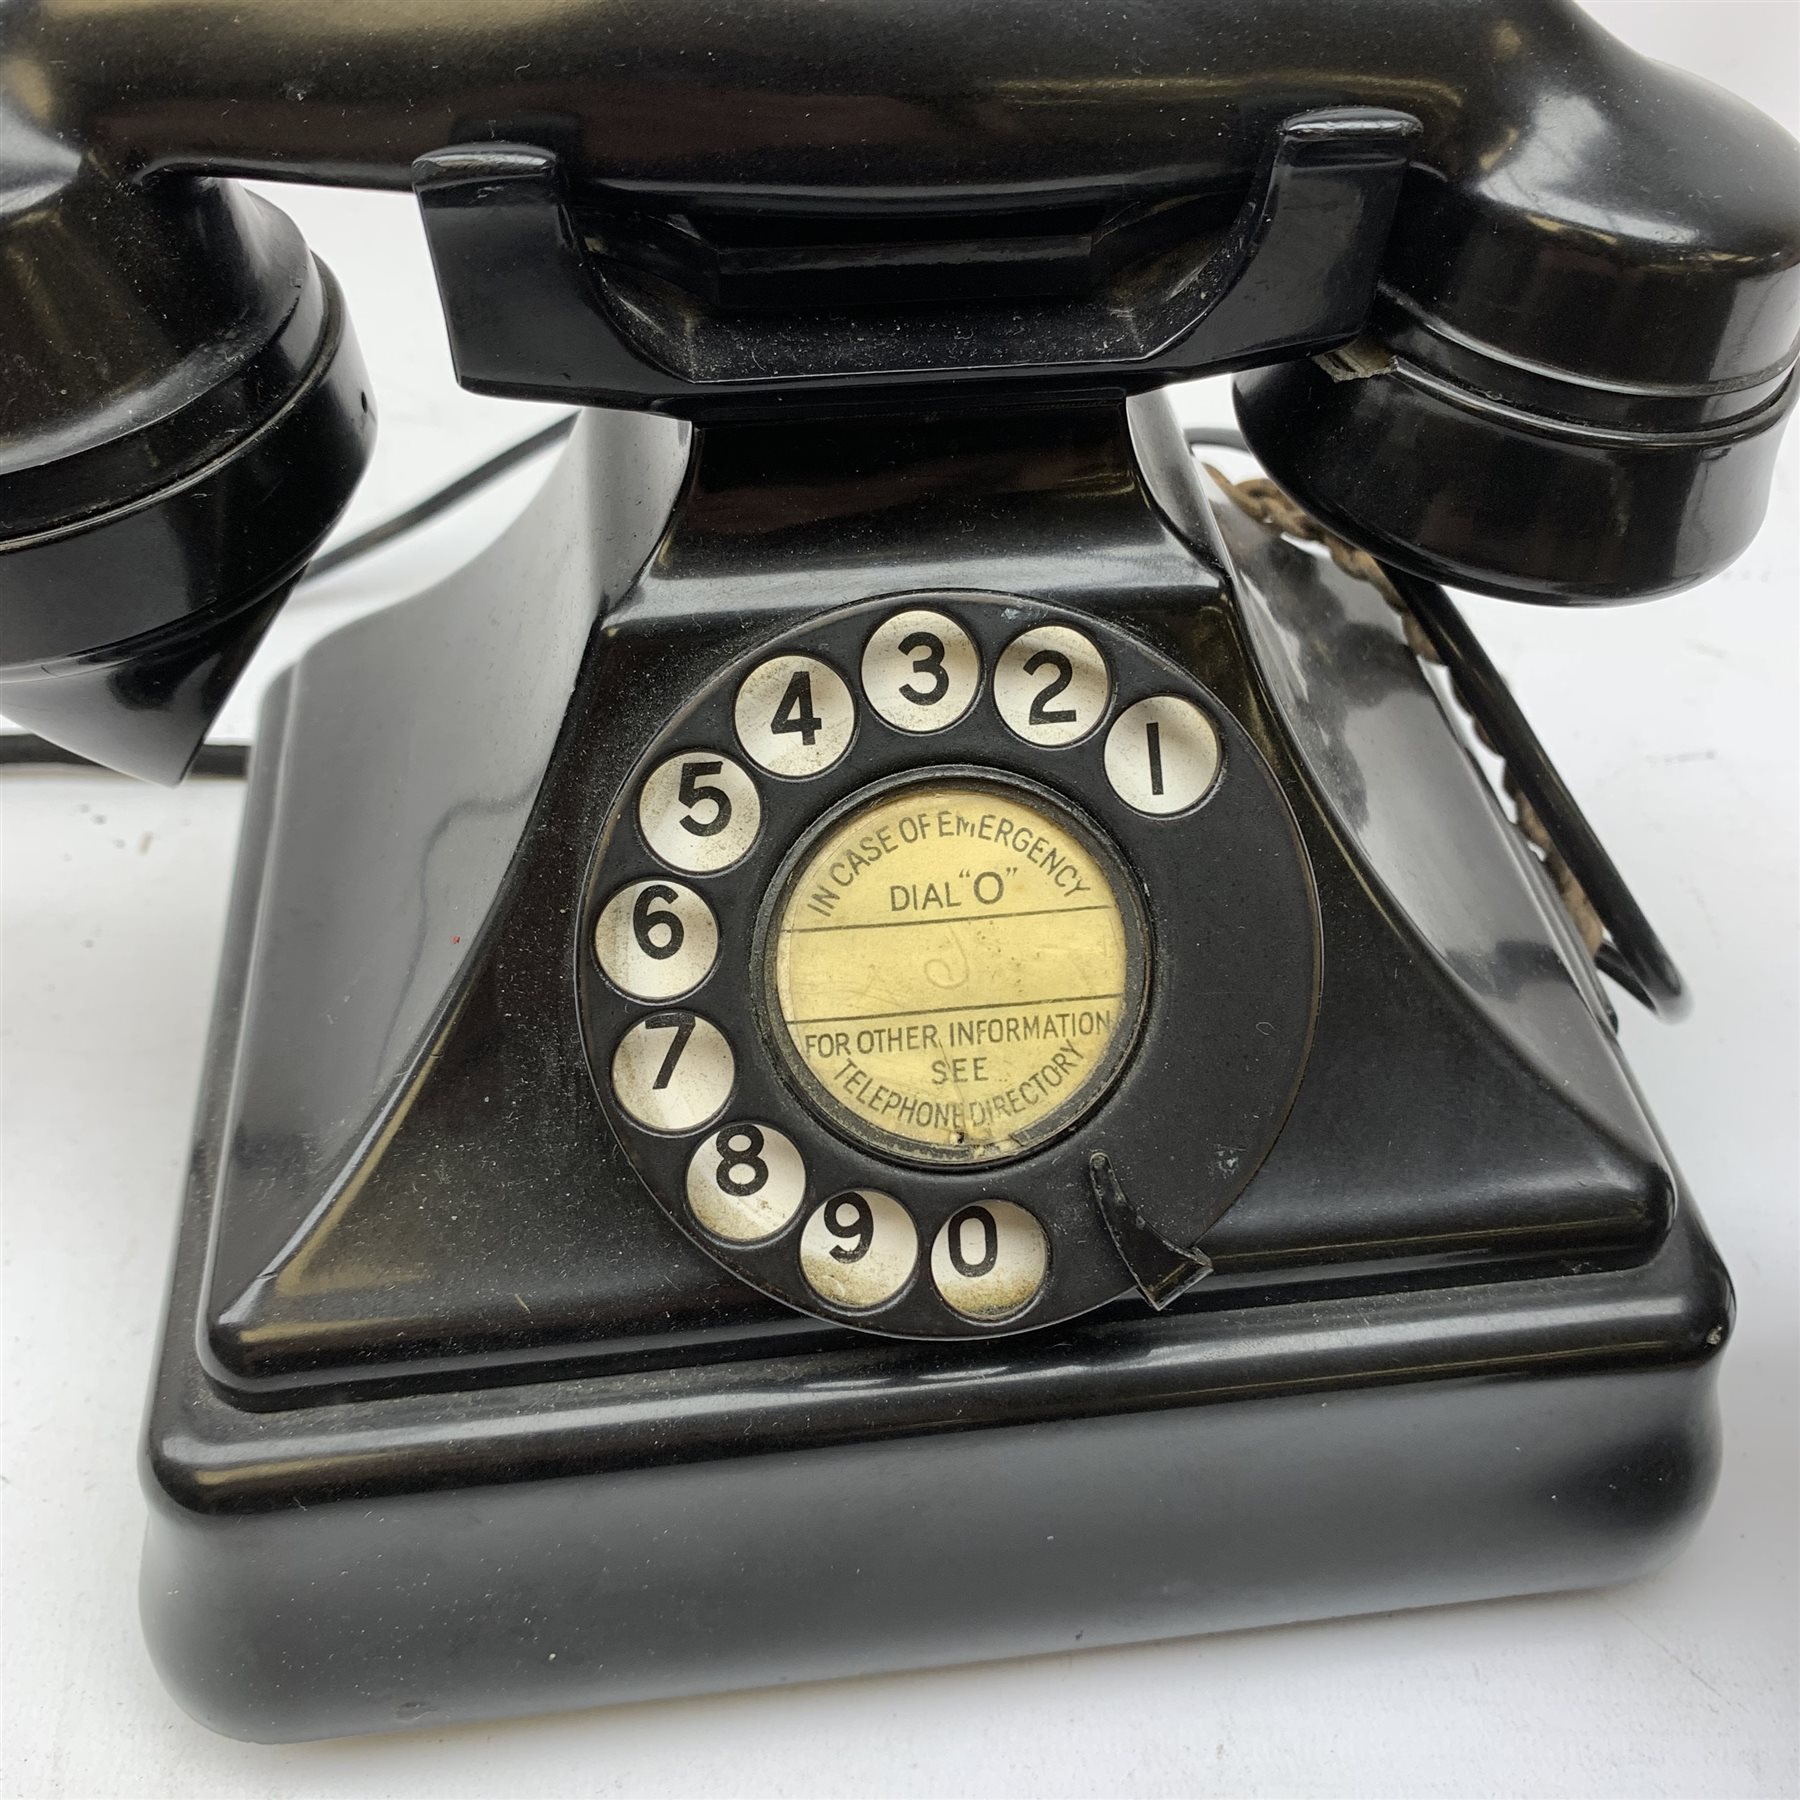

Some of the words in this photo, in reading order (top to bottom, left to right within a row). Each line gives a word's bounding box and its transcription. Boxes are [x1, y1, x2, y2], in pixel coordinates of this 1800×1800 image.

[899, 631, 950, 705] 3
[1023, 650, 1077, 725] 2
[770, 671, 822, 745] 4
[1147, 722, 1163, 795] 1
[678, 761, 732, 837] 5
[807, 885, 840, 917] IN
[830, 825, 898, 888] CASE
[899, 813, 931, 844] OF
[937, 810, 1091, 898] EMERGENCY
[890, 883, 961, 912] DIAL
[632, 885, 684, 960] 6
[645, 1013, 696, 1090] 7
[805, 1034, 851, 1058] FOR
[857, 1024, 938, 1055] OTHER
[949, 1010, 1110, 1047] INFORMATION
[932, 1057, 988, 1085] SEE
[834, 1059, 965, 1129] TELEPHONE
[969, 1040, 1084, 1127] DIRECTORY
[715, 1124, 769, 1198] 8
[823, 1192, 874, 1264] 9
[948, 1205, 998, 1277] 0
